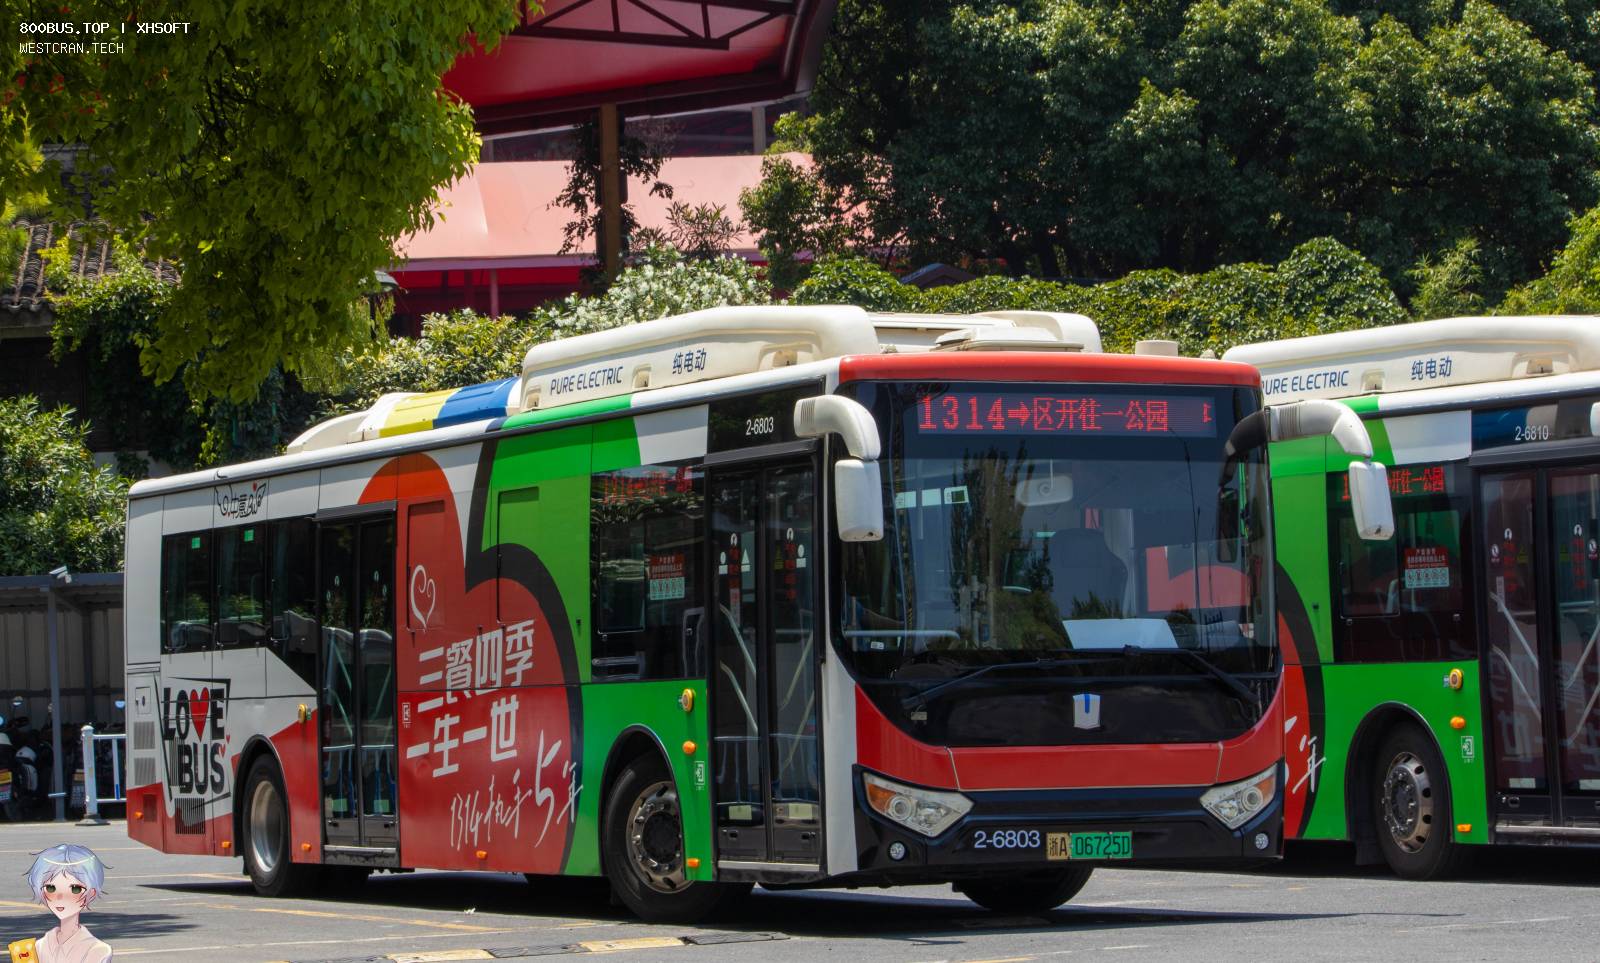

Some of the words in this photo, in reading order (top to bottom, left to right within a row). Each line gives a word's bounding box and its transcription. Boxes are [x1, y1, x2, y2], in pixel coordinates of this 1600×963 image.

[672, 348, 707, 375] 纯电动
[1411, 356, 1453, 382] 纯电动
[550, 374, 575, 396] PURE
[577, 366, 624, 391] ELECTRIC
[1291, 370, 1350, 392] ELECTRIC
[745, 416, 775, 437] 2-6803
[919, 395, 1006, 430] 1314
[1514, 424, 1550, 442] 2-6810
[1387, 466, 1445, 495] 开往一公园
[417, 620, 535, 713] 三餐四季
[406, 694, 520, 778] 一生一世
[177, 742, 226, 795] BUS
[973, 830, 1042, 850] 2-6803
